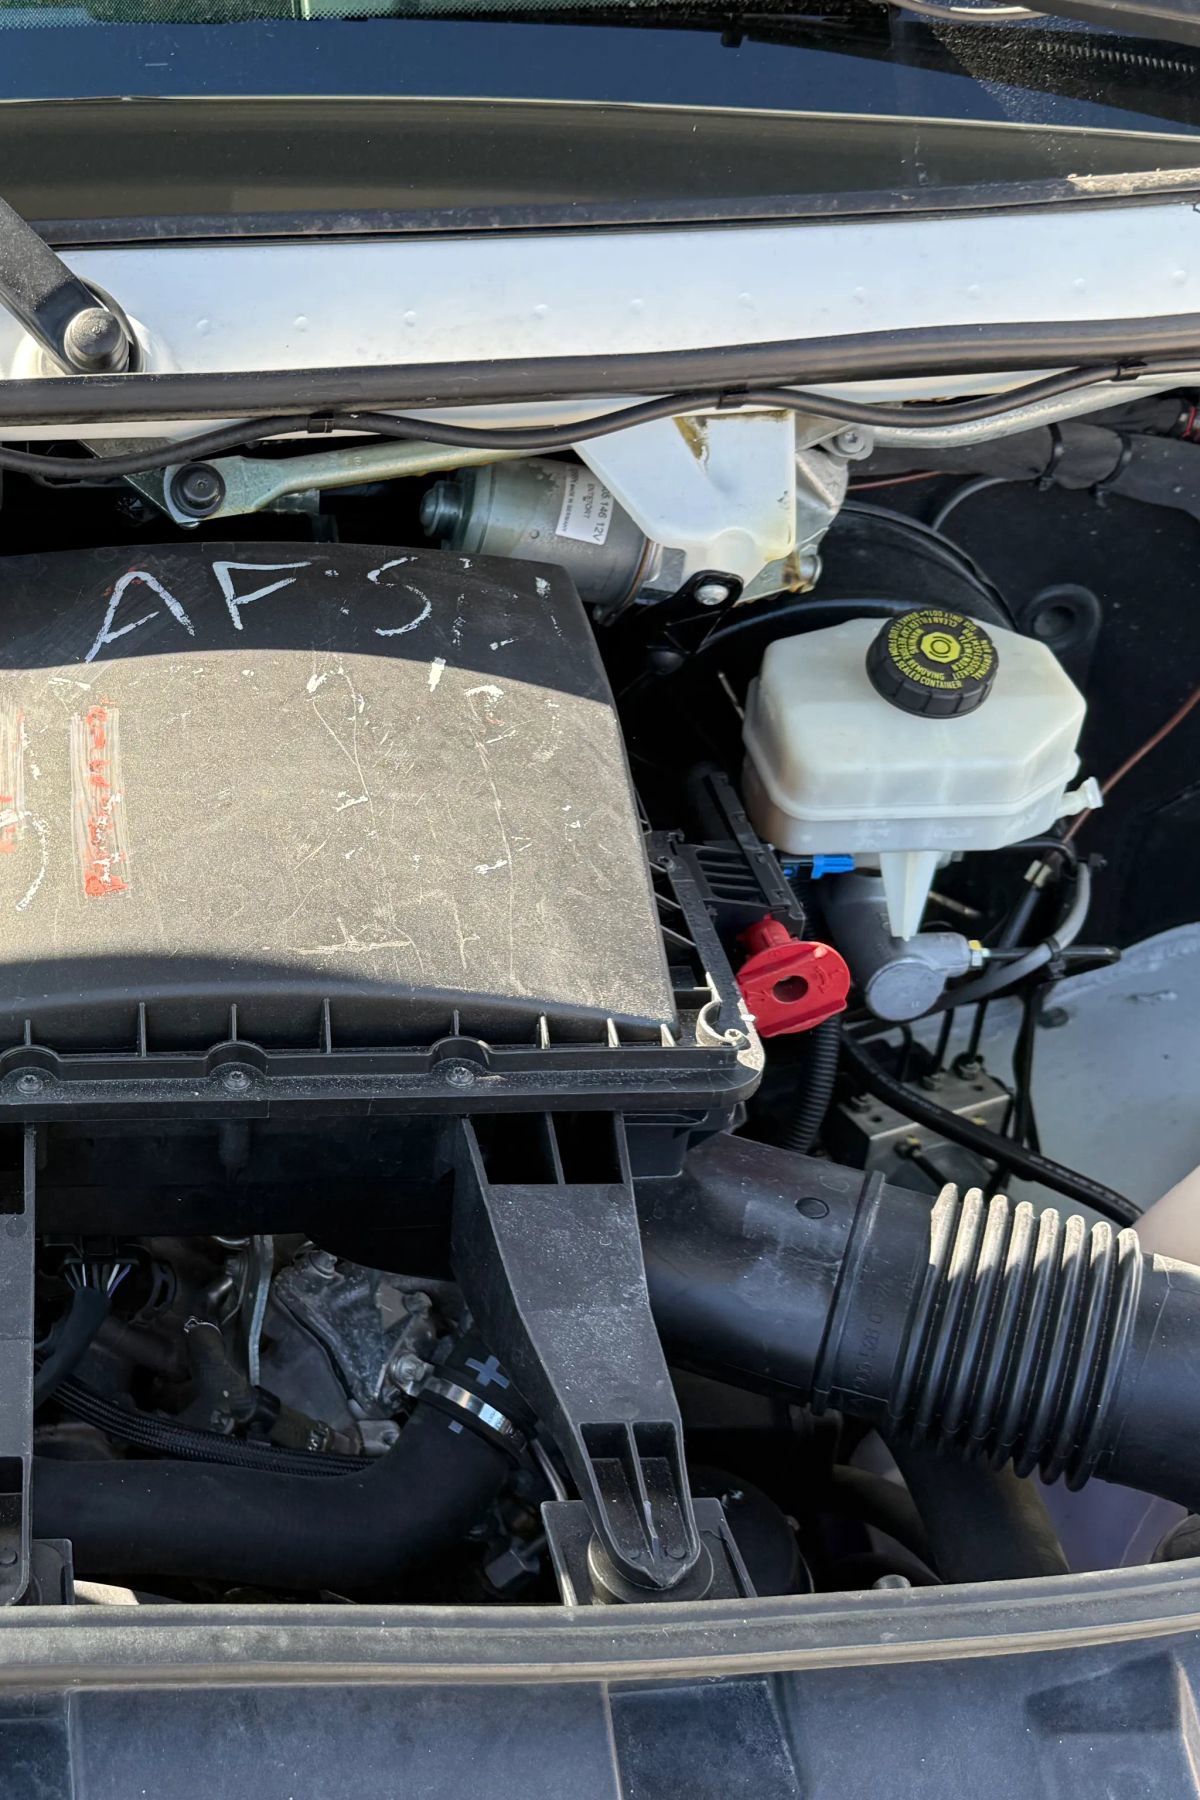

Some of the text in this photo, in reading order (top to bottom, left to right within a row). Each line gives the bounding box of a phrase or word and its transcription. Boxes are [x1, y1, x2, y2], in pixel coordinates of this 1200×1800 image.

[593, 522, 605, 541] 12V
[888, 639, 899, 656] FROM
[896, 661, 920, 681] SEALED
[920, 677, 963, 689] CONTAINER
[907, 659, 945, 680] REMOVING
